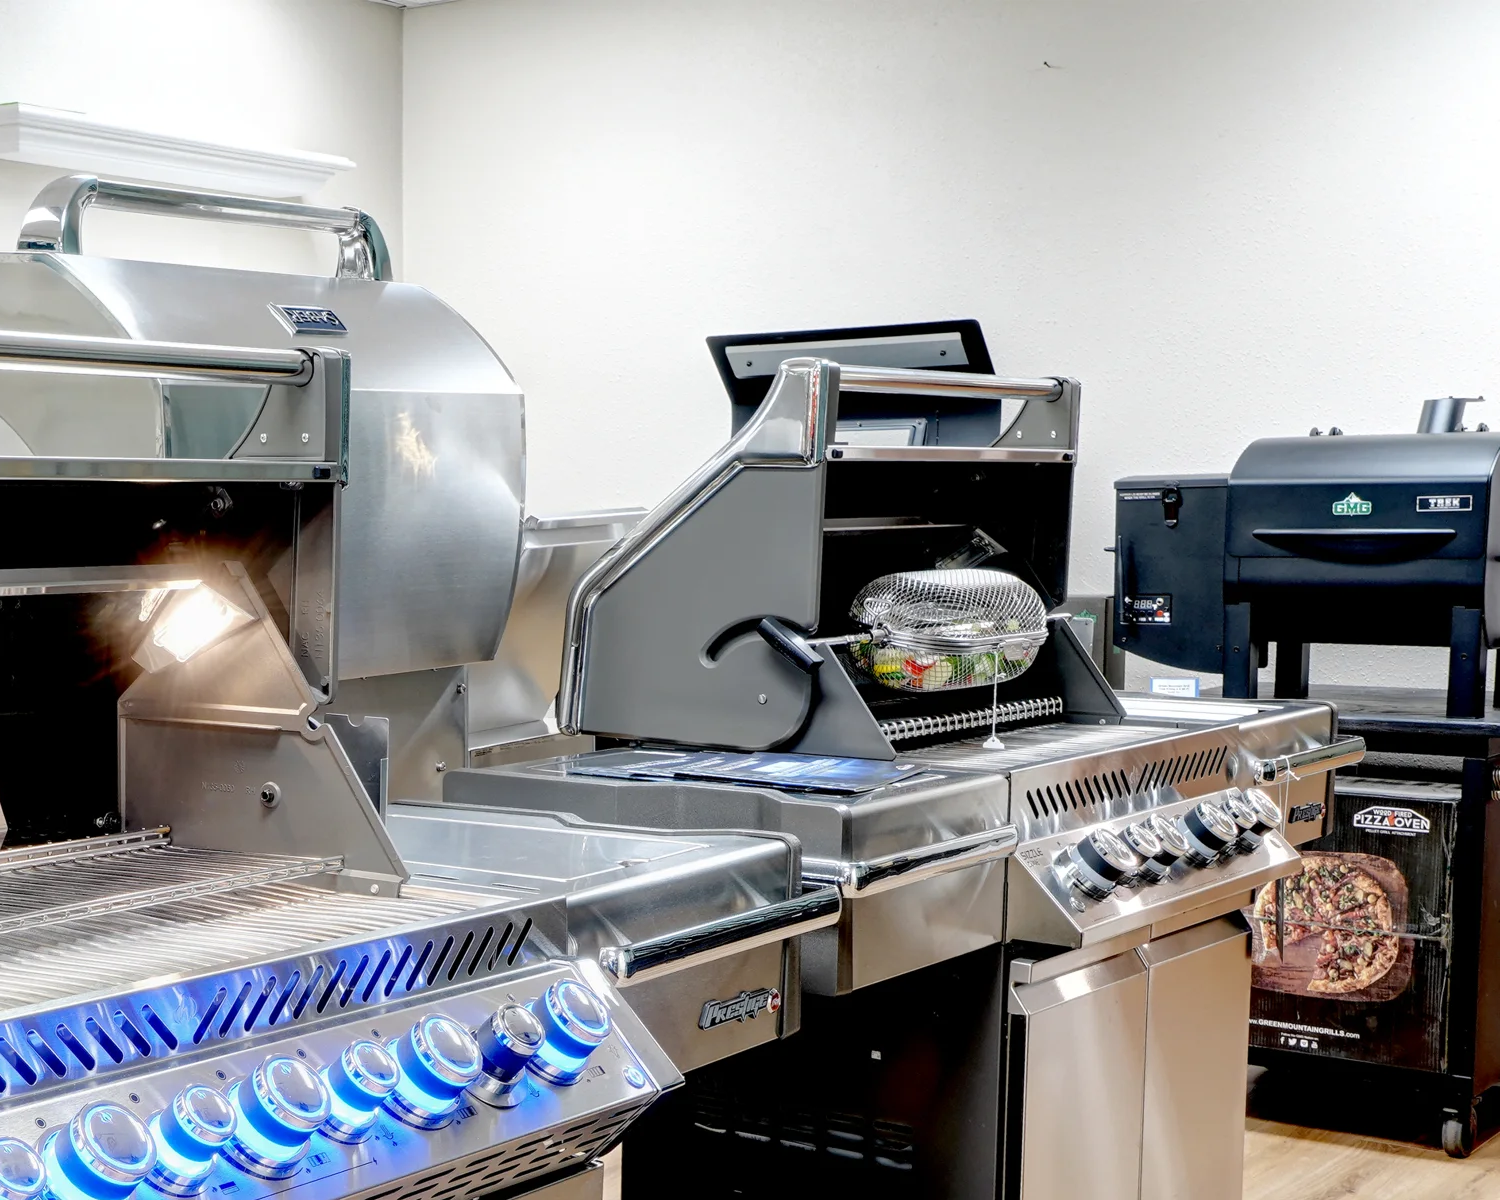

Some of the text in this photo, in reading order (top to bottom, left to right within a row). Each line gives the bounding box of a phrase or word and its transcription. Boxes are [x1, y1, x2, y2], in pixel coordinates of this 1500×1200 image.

[1428, 498, 1460, 507] TREK
[1335, 502, 1371, 514] GMG
[1394, 811, 1412, 819] FIRED
[1354, 814, 1429, 830] PIZZA OVEN
